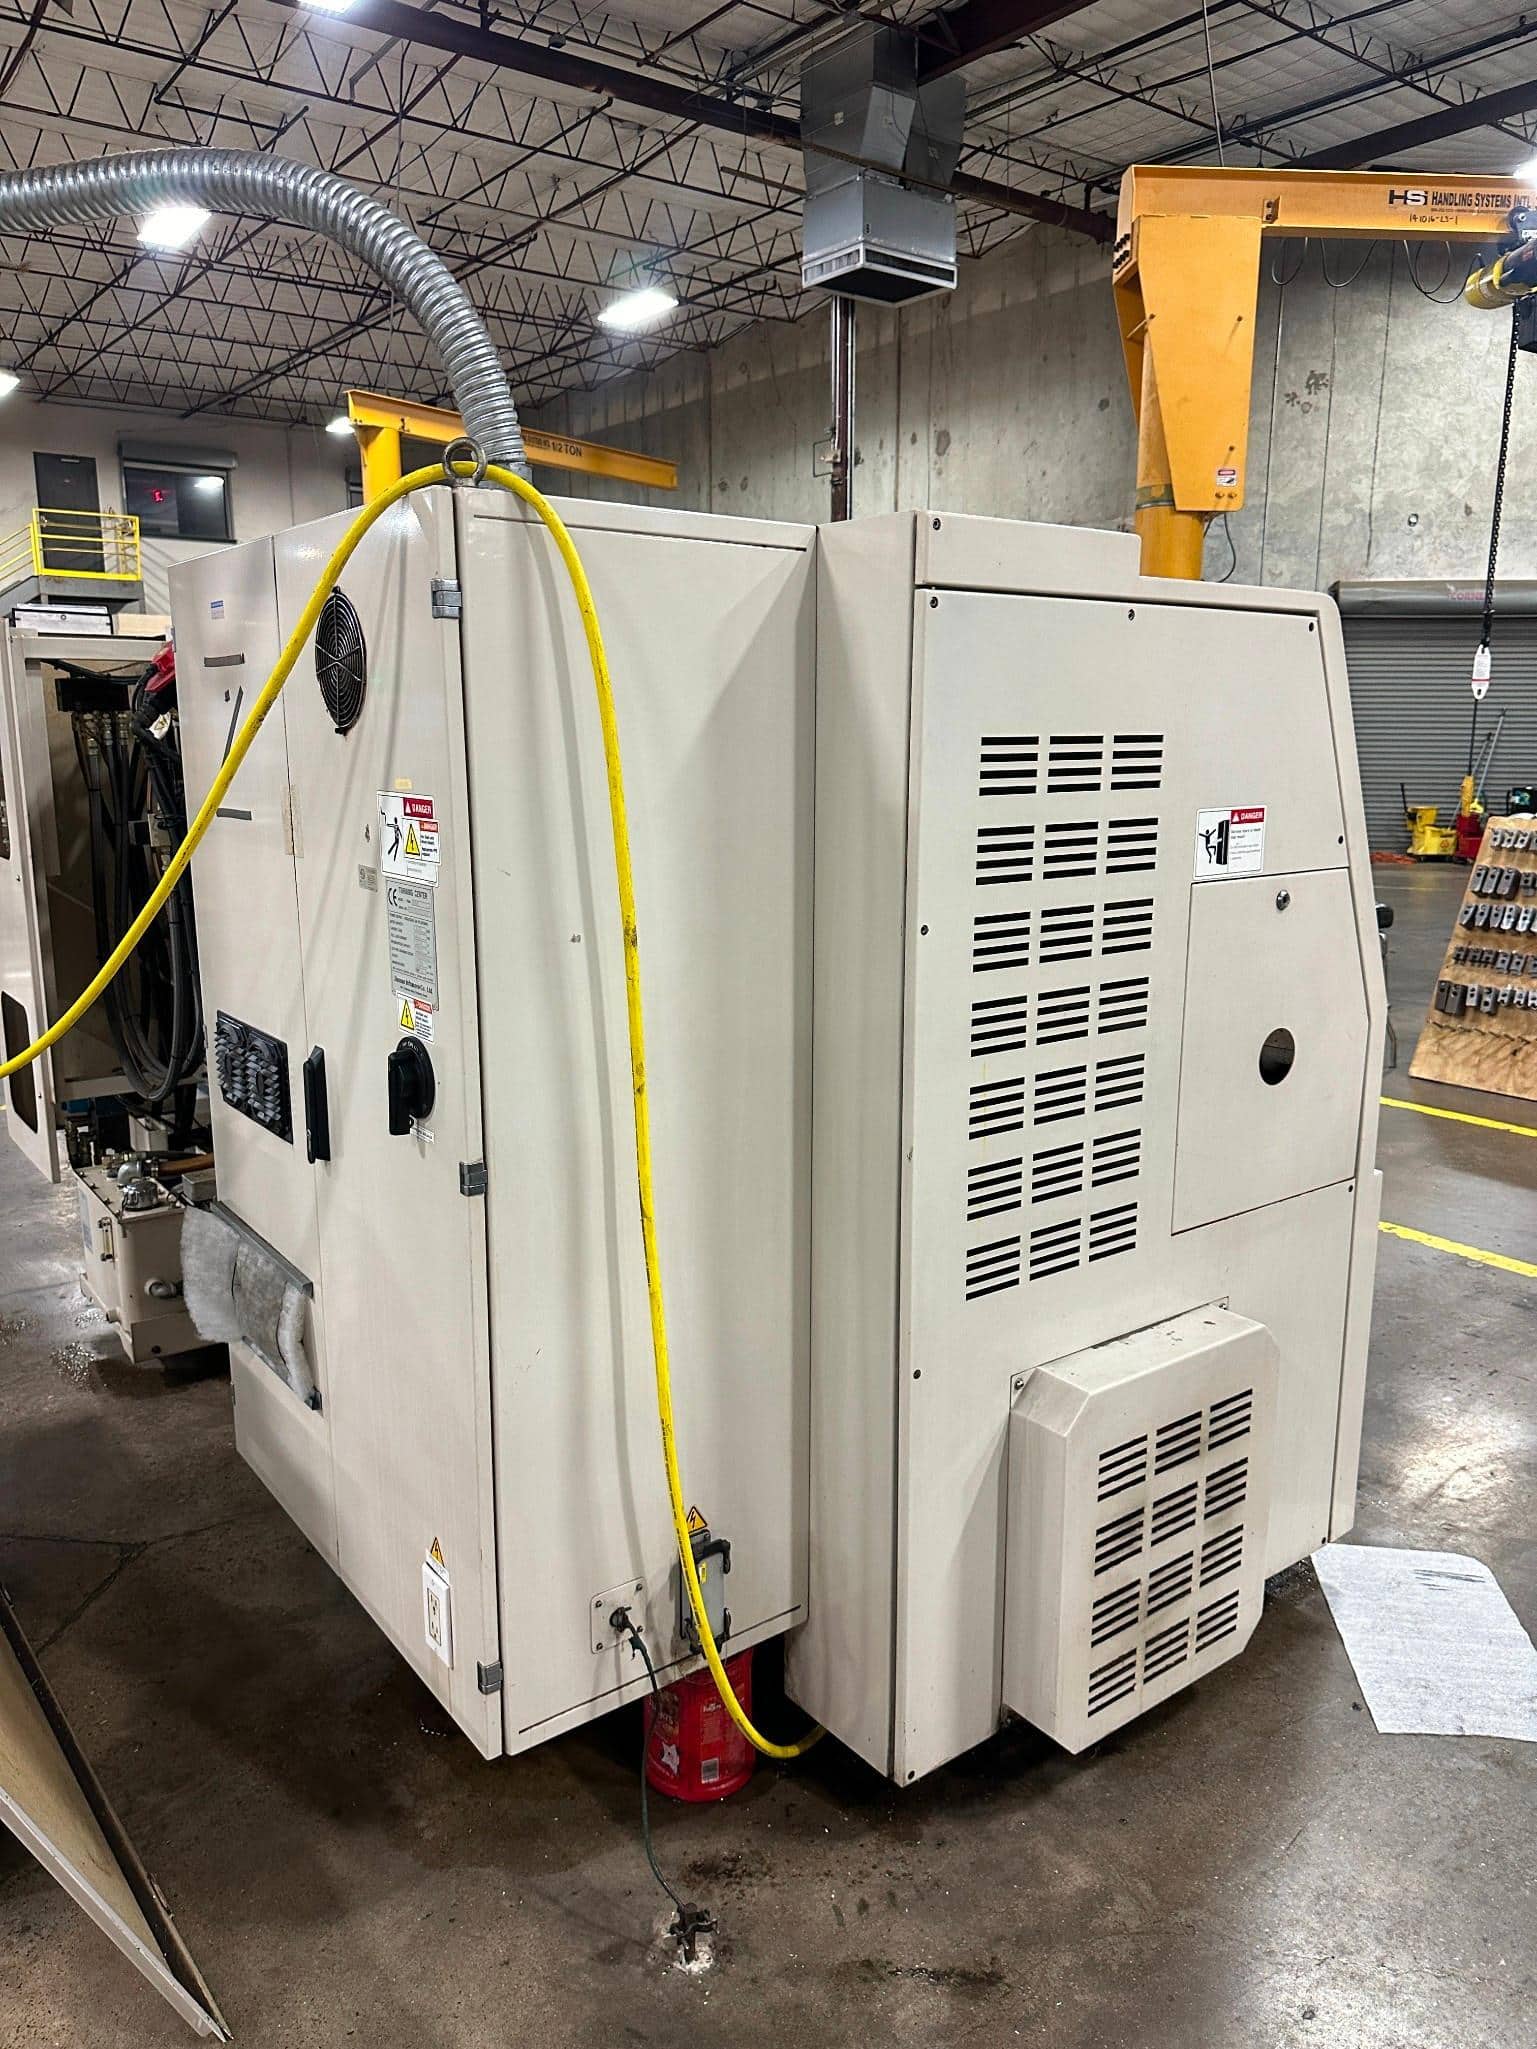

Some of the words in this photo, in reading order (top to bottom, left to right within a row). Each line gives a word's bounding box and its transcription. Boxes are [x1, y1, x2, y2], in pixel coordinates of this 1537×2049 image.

[1432, 192, 1472, 206] HANDLING
[1475, 193, 1511, 208] SYSTEMS
[565, 444, 582, 457] TON
[411, 803, 432, 814] DANGER
[1240, 811, 1263, 820] DANGER
